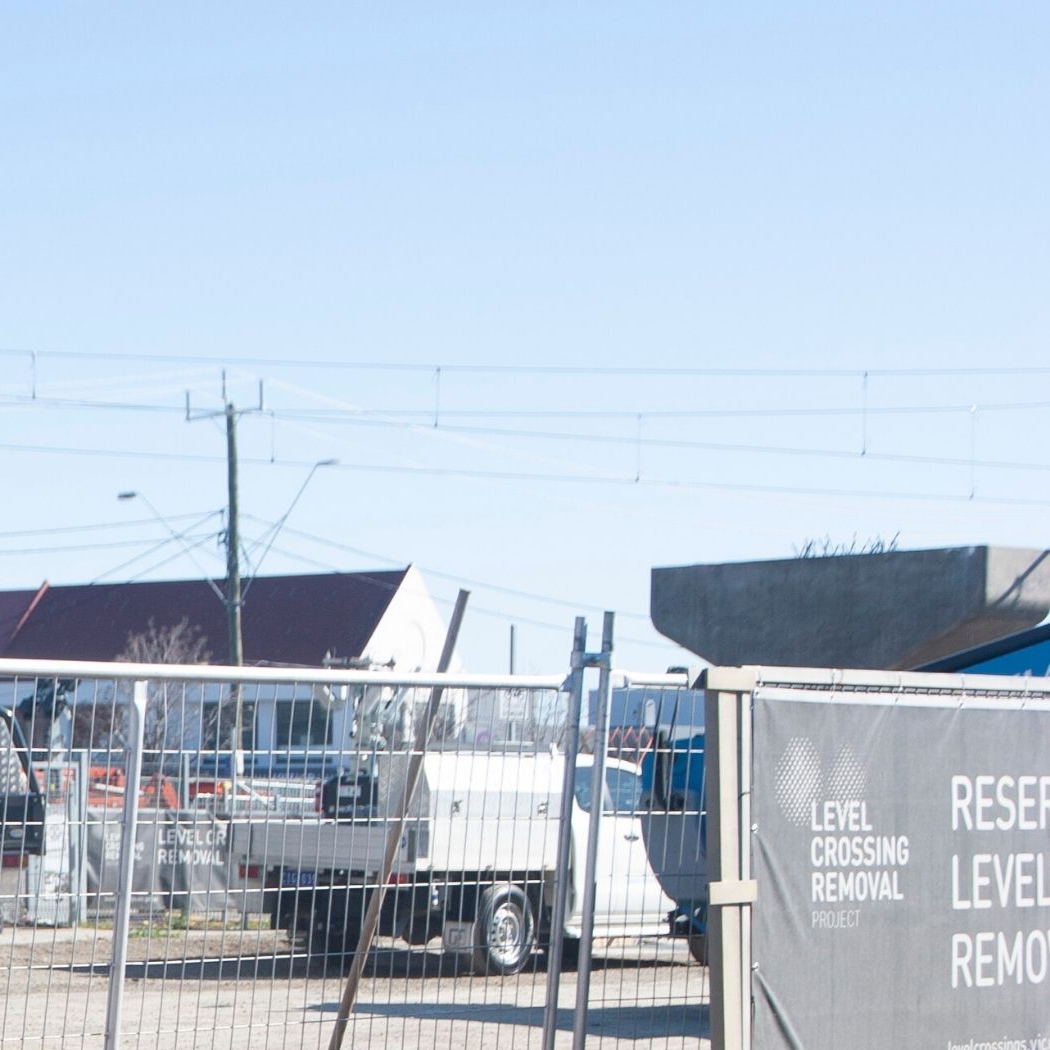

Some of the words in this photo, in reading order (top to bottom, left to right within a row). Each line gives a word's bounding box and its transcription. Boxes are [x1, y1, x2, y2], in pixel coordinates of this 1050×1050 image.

[811, 800, 873, 831] LEVEL
[158, 828, 203, 846] LEVEL
[810, 835, 909, 867] CROSSING
[157, 848, 225, 866] REMOVAL
[811, 870, 904, 902] REMOVAL
[952, 853, 1050, 909] LEVEL
[812, 910, 861, 929] PROJECT
[951, 930, 1050, 988] REMO
